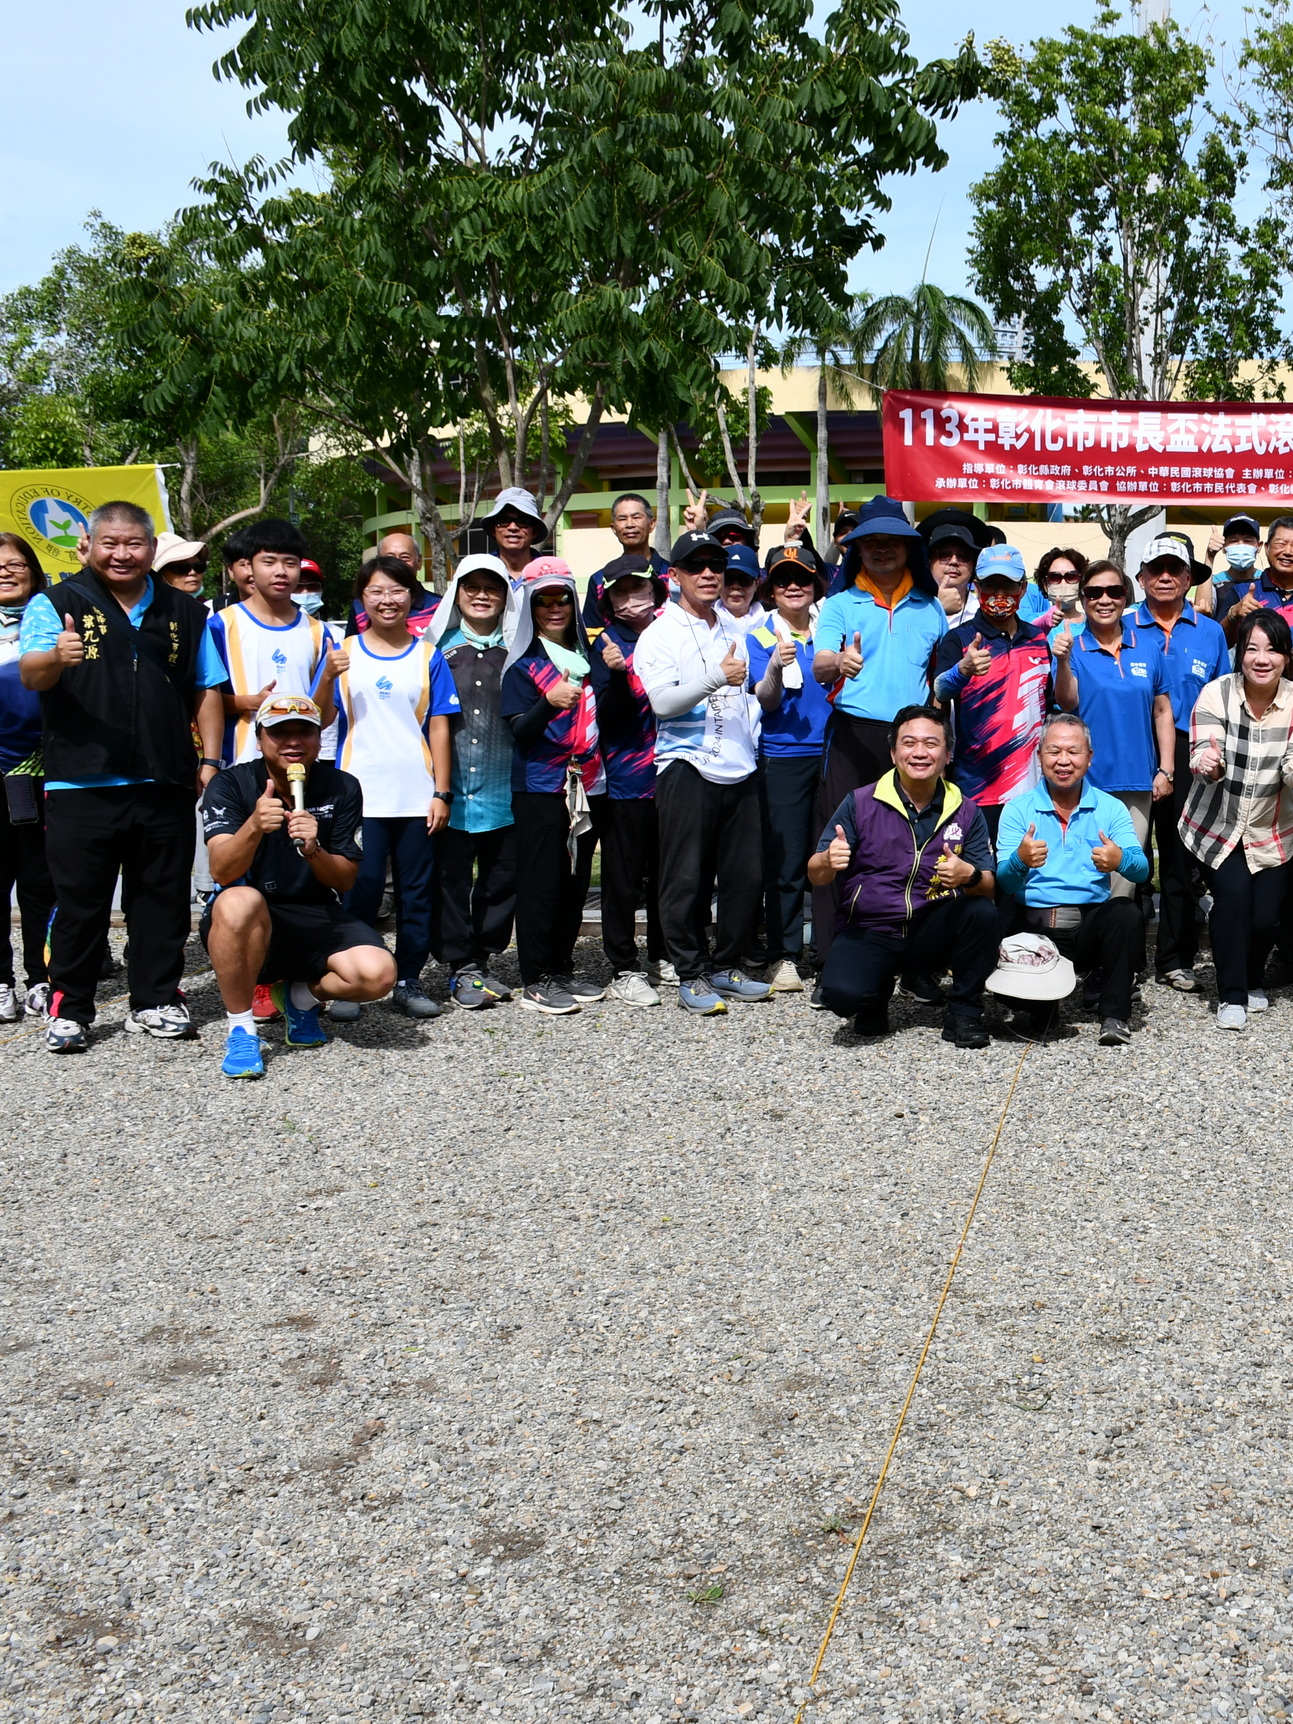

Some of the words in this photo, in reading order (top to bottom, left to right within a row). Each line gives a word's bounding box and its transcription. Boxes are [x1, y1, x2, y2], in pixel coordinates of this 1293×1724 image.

[962, 462, 1235, 480] 指導單位：彰化縣政府、彰化市公所、中華民國滾球協會
[934, 477, 1110, 492] 承辦單位：彰化市體育會滾球委員會
